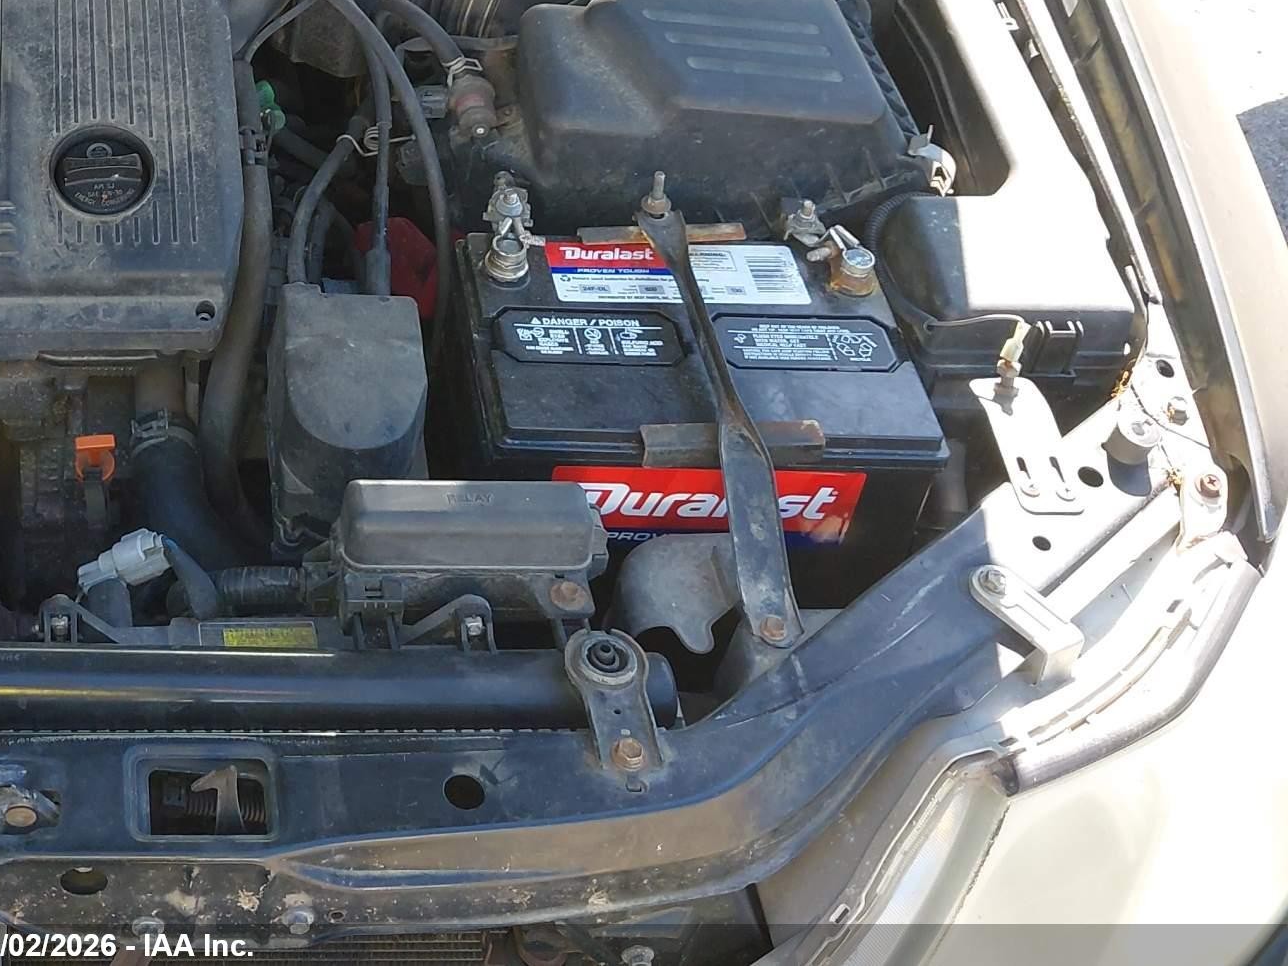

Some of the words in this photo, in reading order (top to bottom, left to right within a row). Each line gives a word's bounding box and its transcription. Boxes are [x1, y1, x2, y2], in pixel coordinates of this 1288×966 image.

[559, 247, 654, 260] Duralast
[542, 318, 588, 326] DANGER
[599, 319, 640, 327] POISON
[579, 483, 836, 520] Durast
